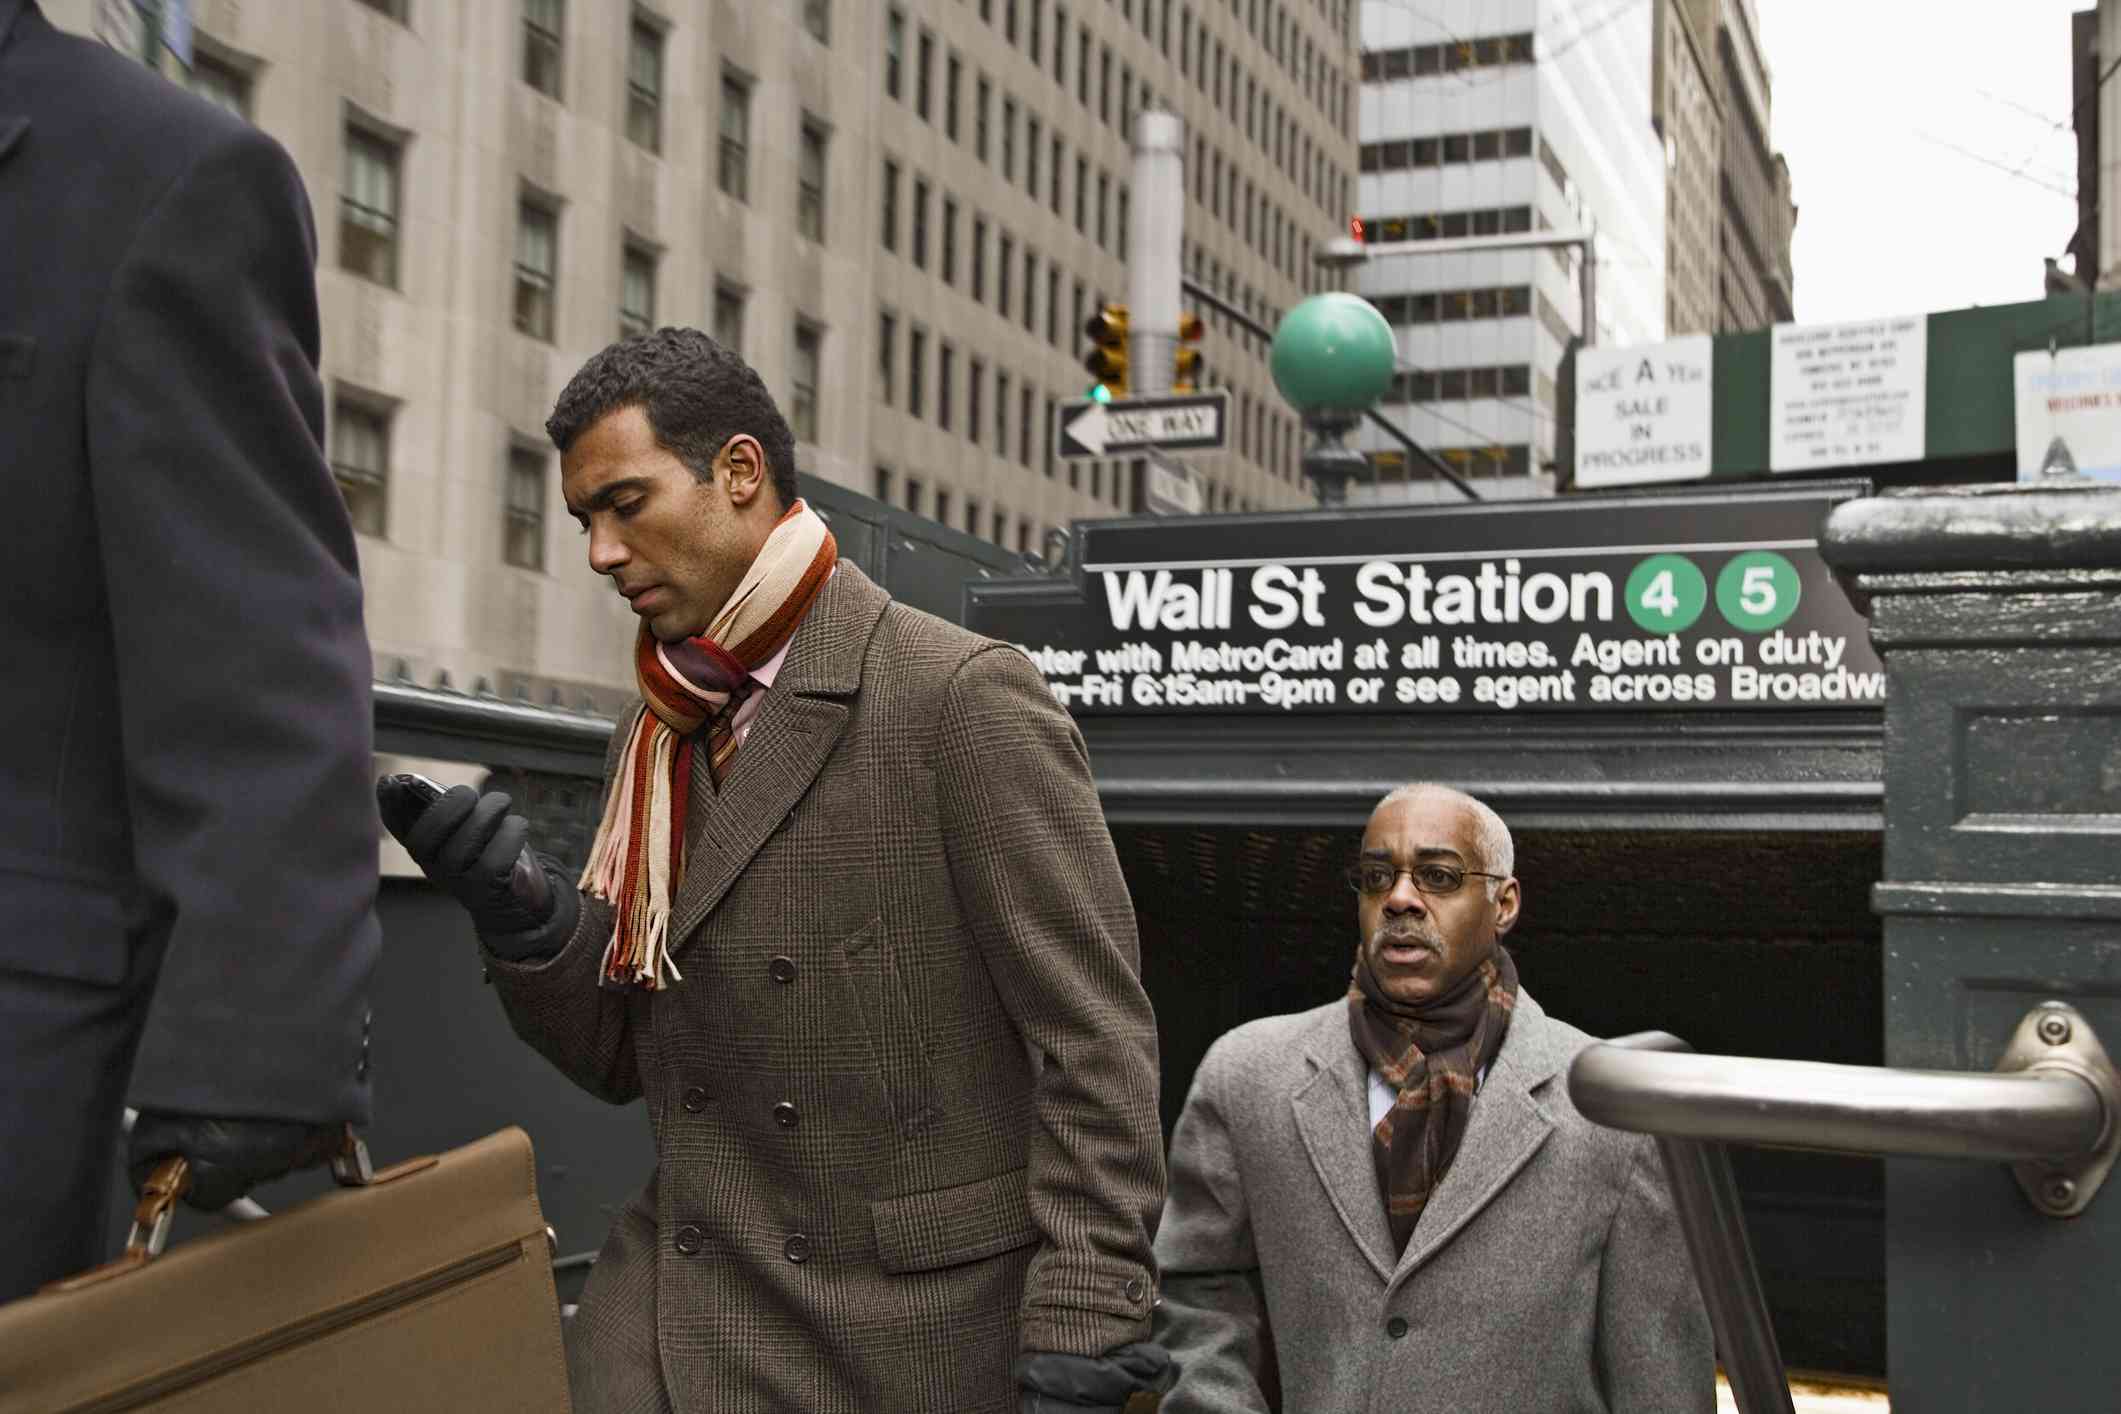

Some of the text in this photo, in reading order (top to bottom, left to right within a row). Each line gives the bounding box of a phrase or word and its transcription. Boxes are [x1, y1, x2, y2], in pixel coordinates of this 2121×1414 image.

[1108, 411, 1204, 441] ONE WAY
[1102, 559, 1777, 630] Wall St Station 4 5
[1013, 629, 1847, 675] nter with MetroCard at all times. Agent on duty
[1345, 676, 1386, 704] or
[1395, 676, 1461, 704] see
[1472, 669, 1576, 710] agent
[1588, 673, 1716, 702] across
[1730, 664, 1886, 701] Broadw
